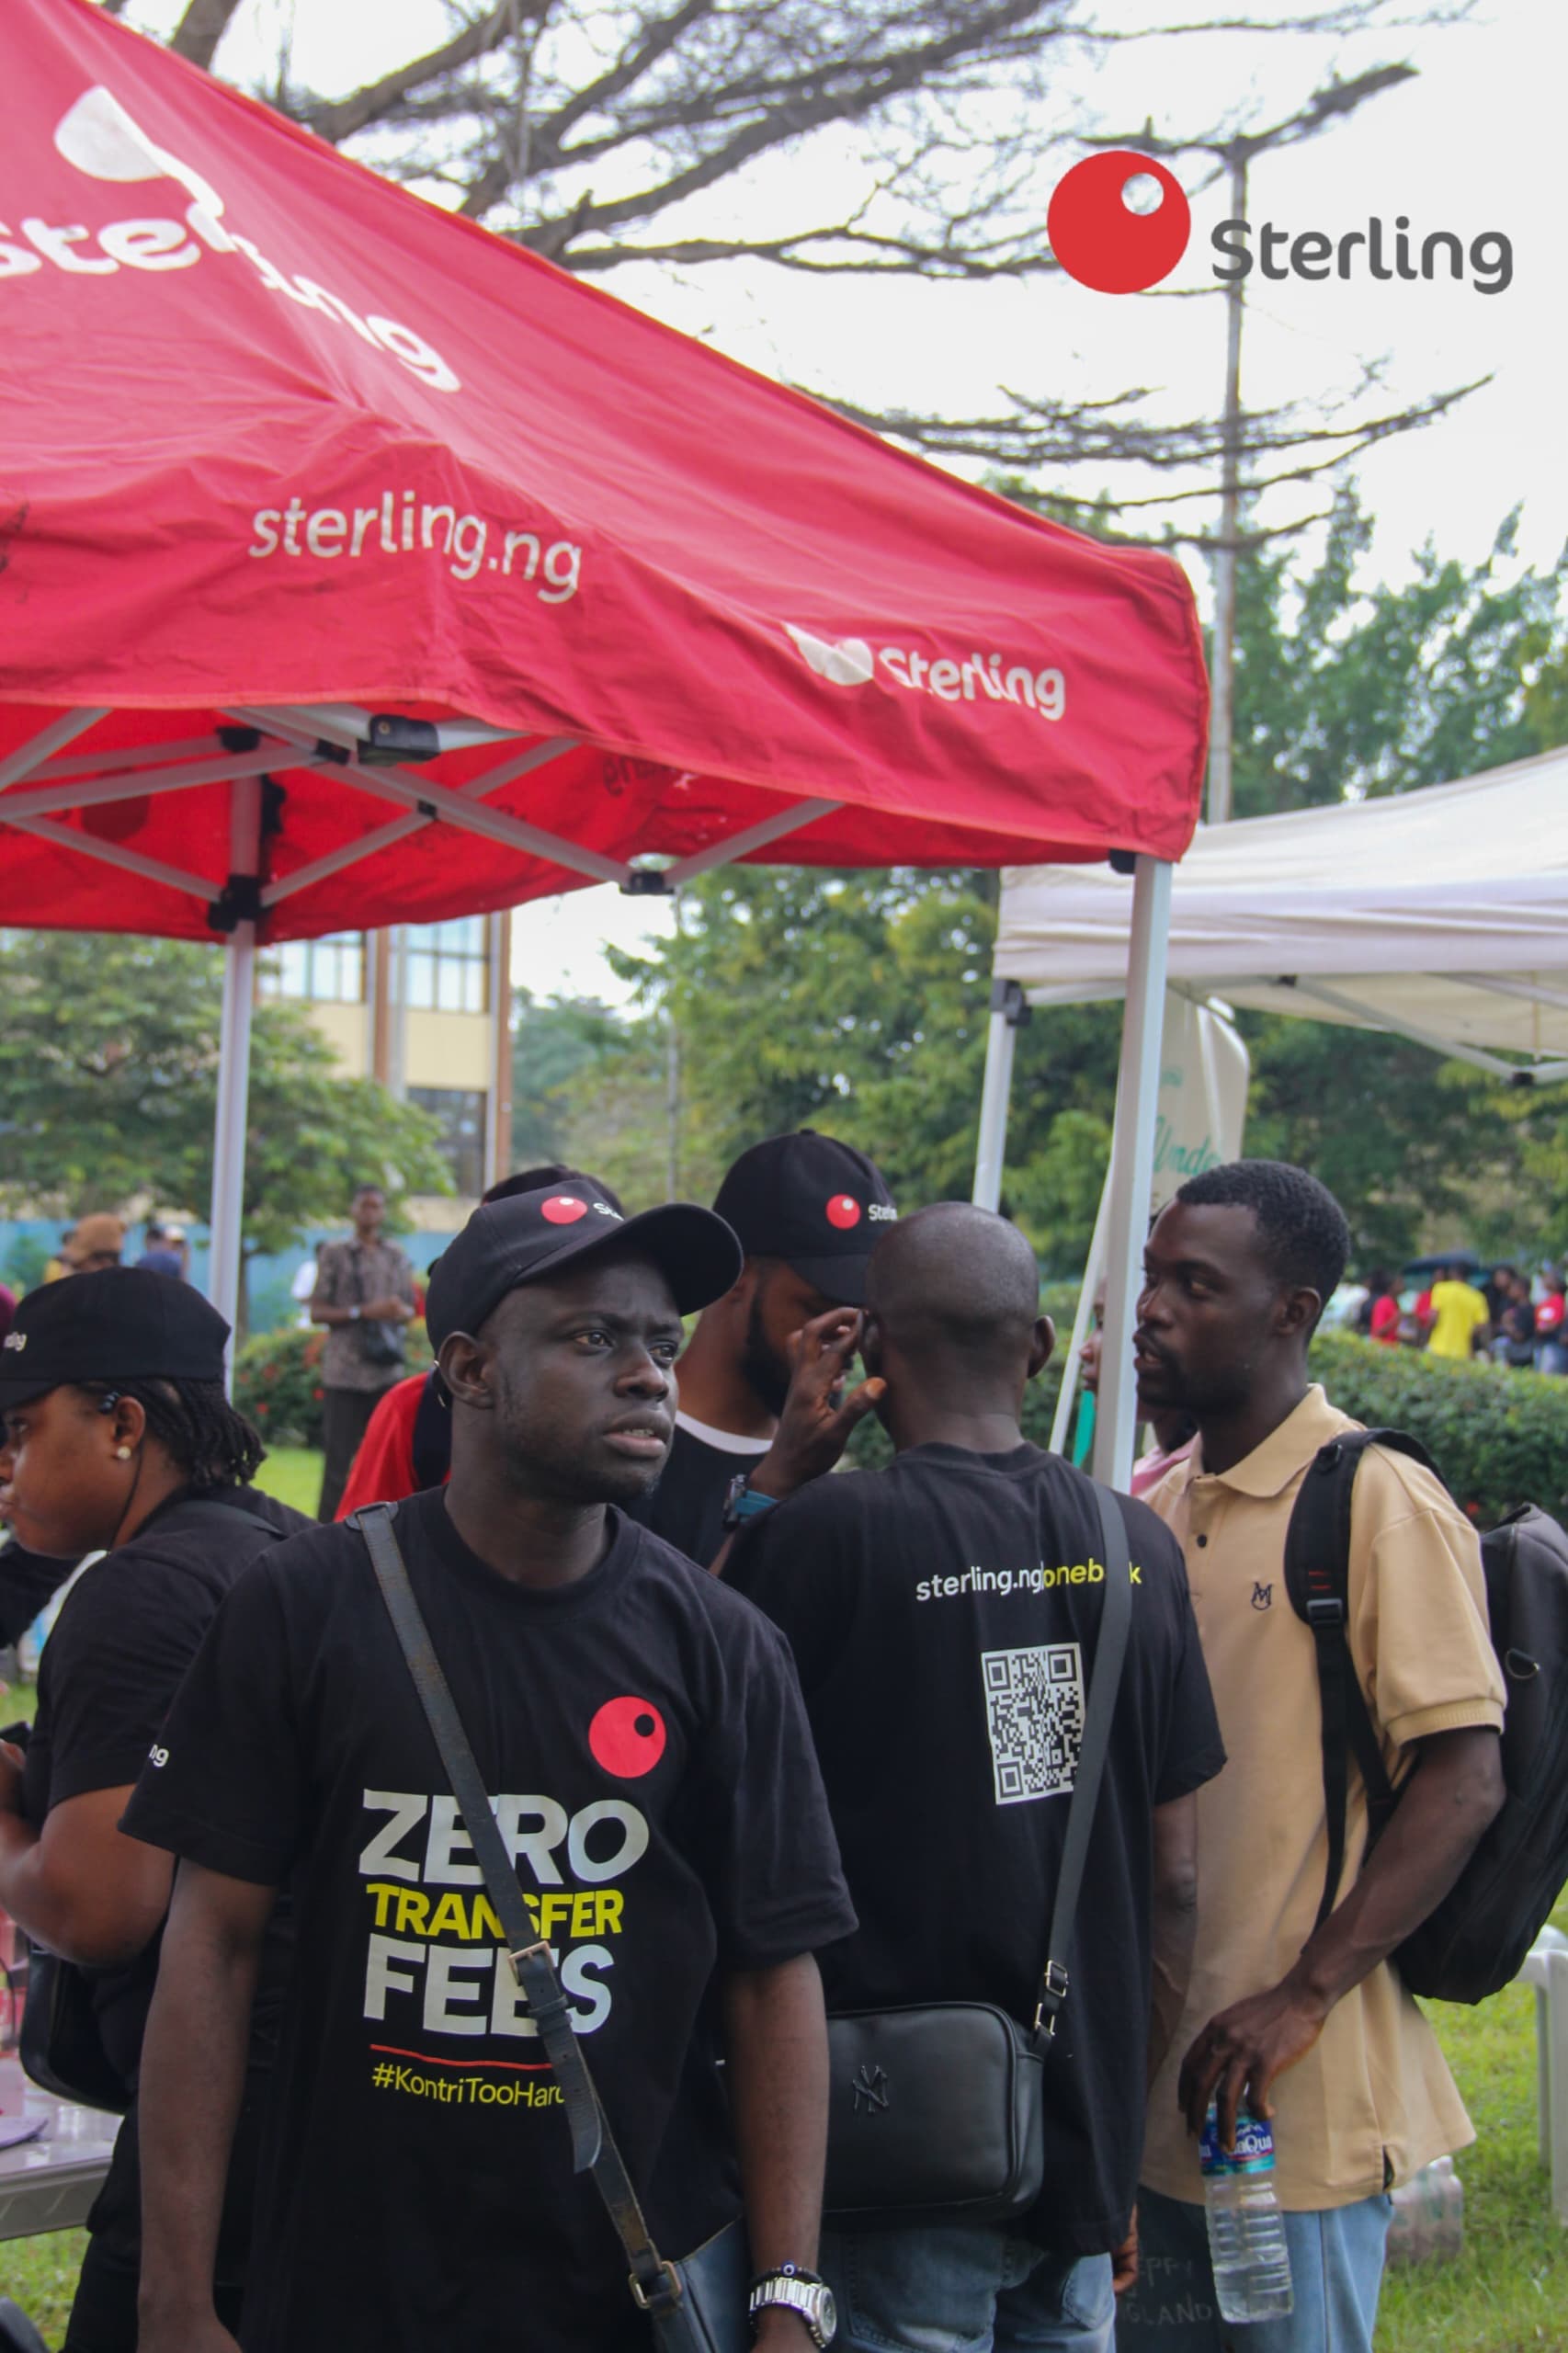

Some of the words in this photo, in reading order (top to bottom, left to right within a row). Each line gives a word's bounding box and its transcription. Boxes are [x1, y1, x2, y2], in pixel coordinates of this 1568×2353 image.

[248, 490, 581, 603] sterling.ng
[358, 1789, 649, 1885] ZERO
[363, 1933, 615, 2037] FEES
